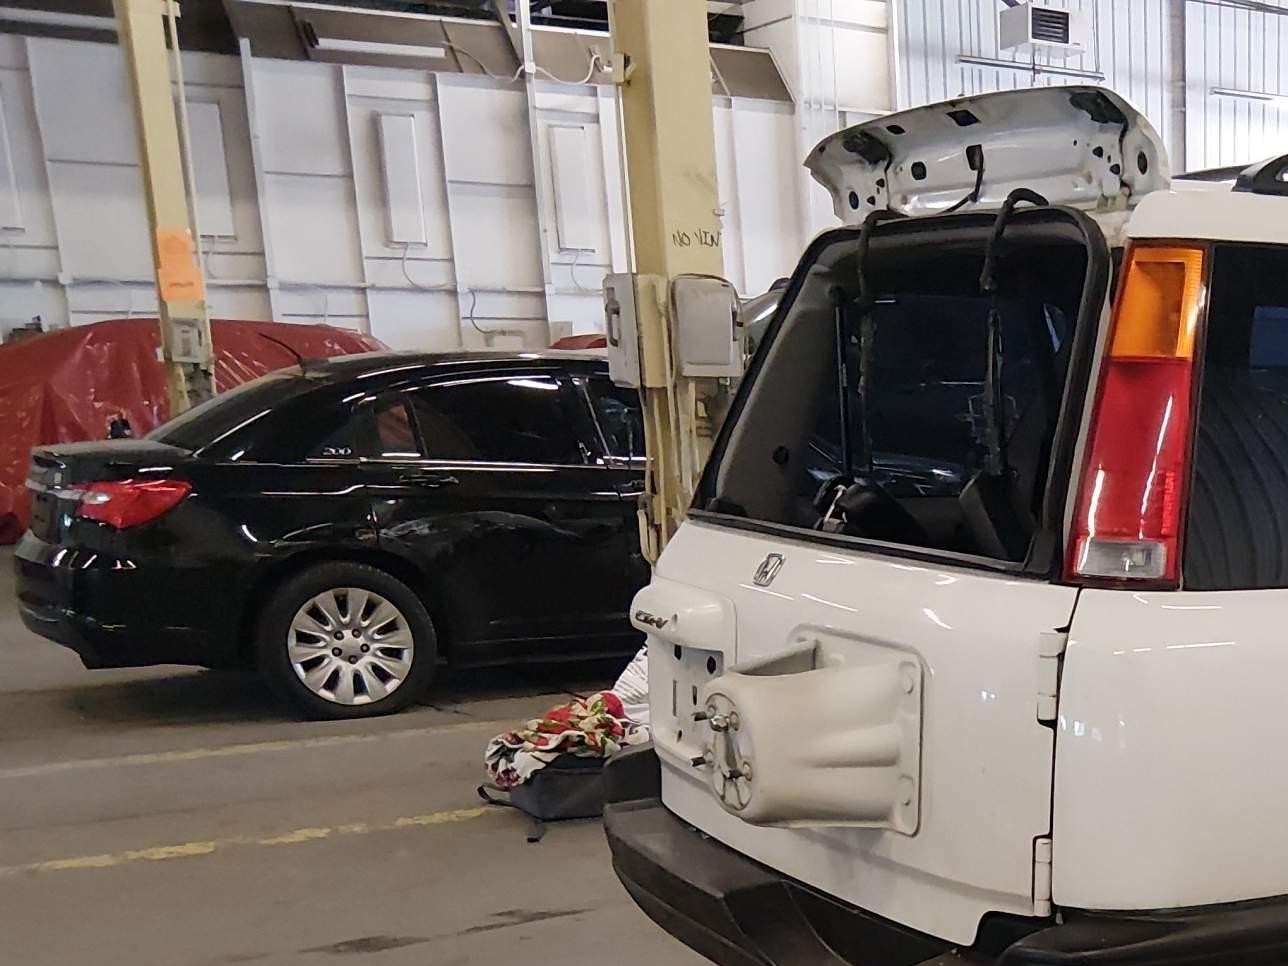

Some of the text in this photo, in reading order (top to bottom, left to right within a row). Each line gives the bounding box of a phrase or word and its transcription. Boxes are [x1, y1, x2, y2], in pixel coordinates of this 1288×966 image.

[672, 227, 722, 248] NO VIN
[322, 446, 352, 456] 200
